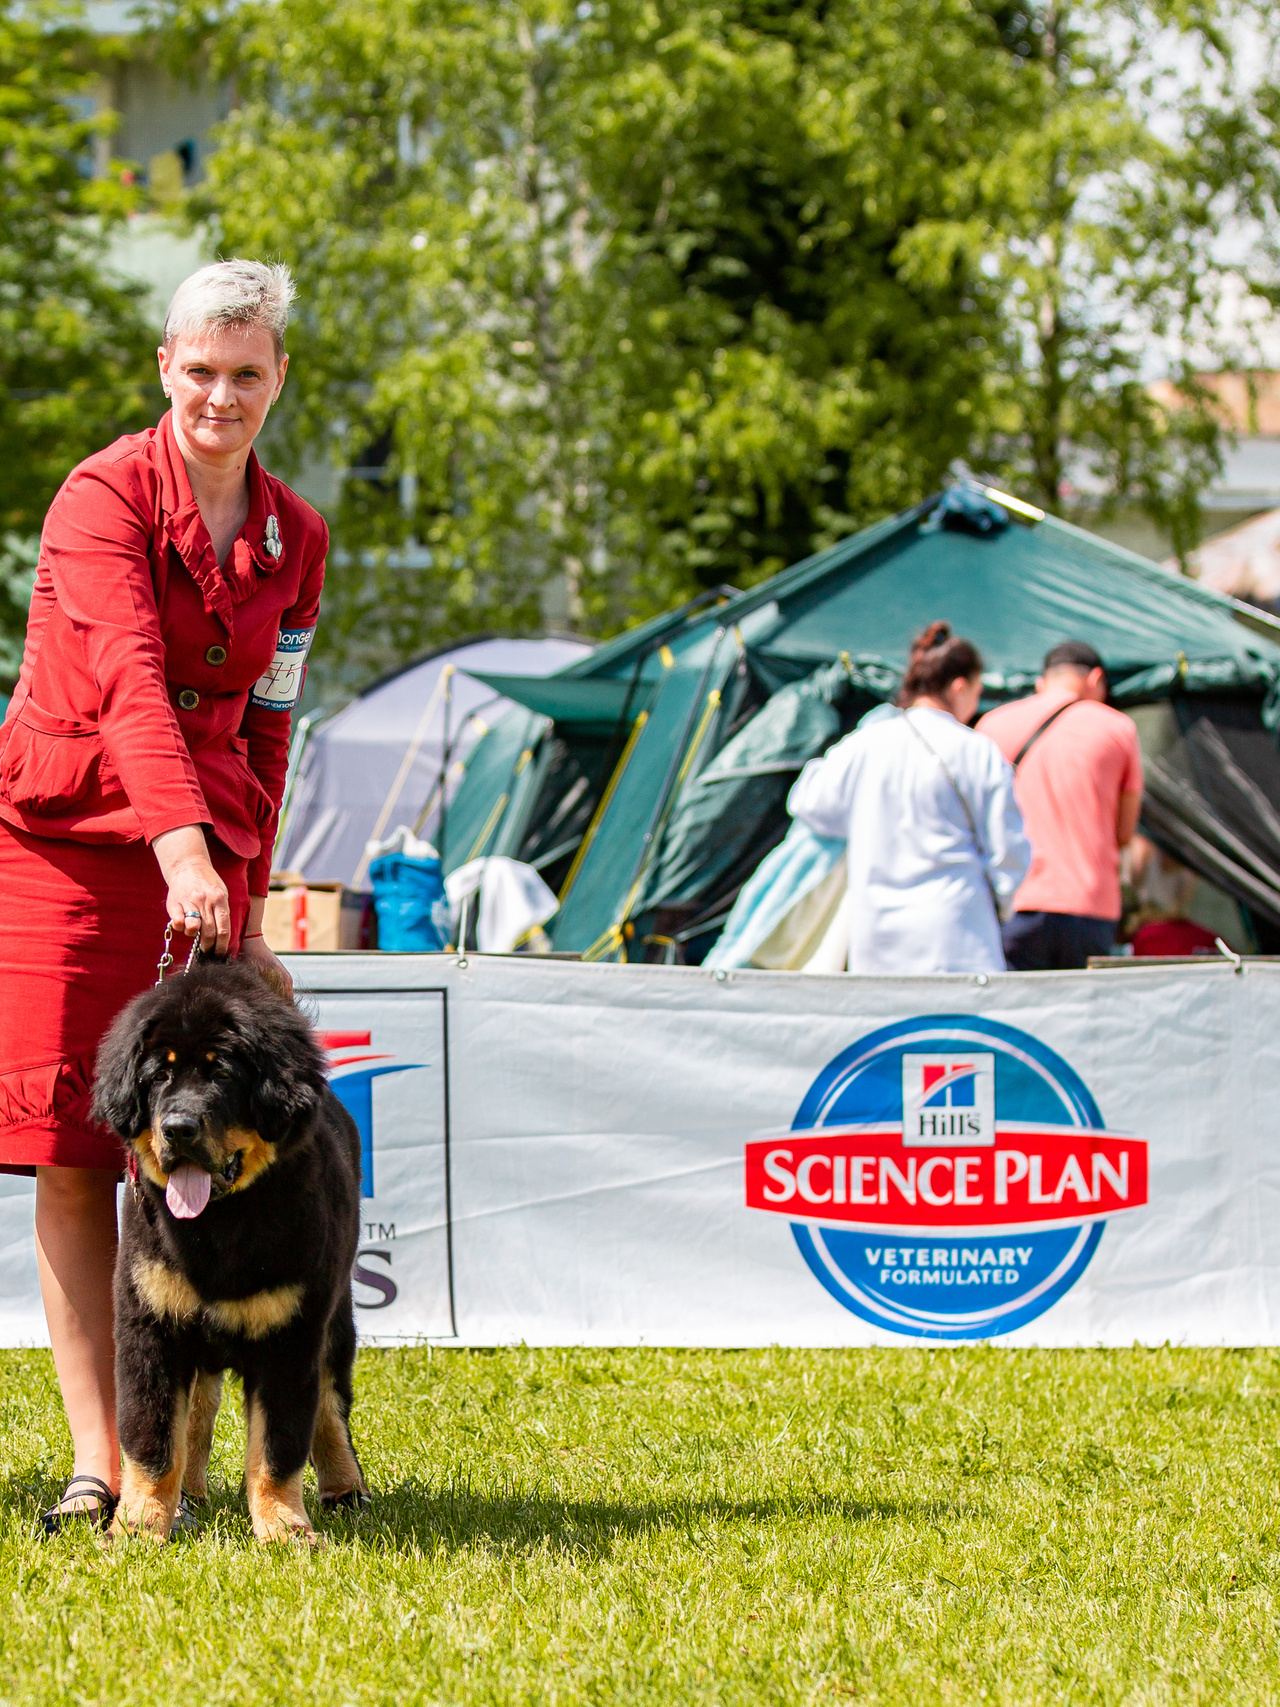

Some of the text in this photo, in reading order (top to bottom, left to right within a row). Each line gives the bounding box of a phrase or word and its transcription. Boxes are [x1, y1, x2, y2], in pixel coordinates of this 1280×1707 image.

[262, 661, 299, 695] 75
[919, 1113, 980, 1136] Hill's
[762, 1149, 1129, 1206] SCIENCE PLAN
[865, 1247, 1033, 1267] VETERINARY
[880, 1269, 1020, 1285] FORMULATED
